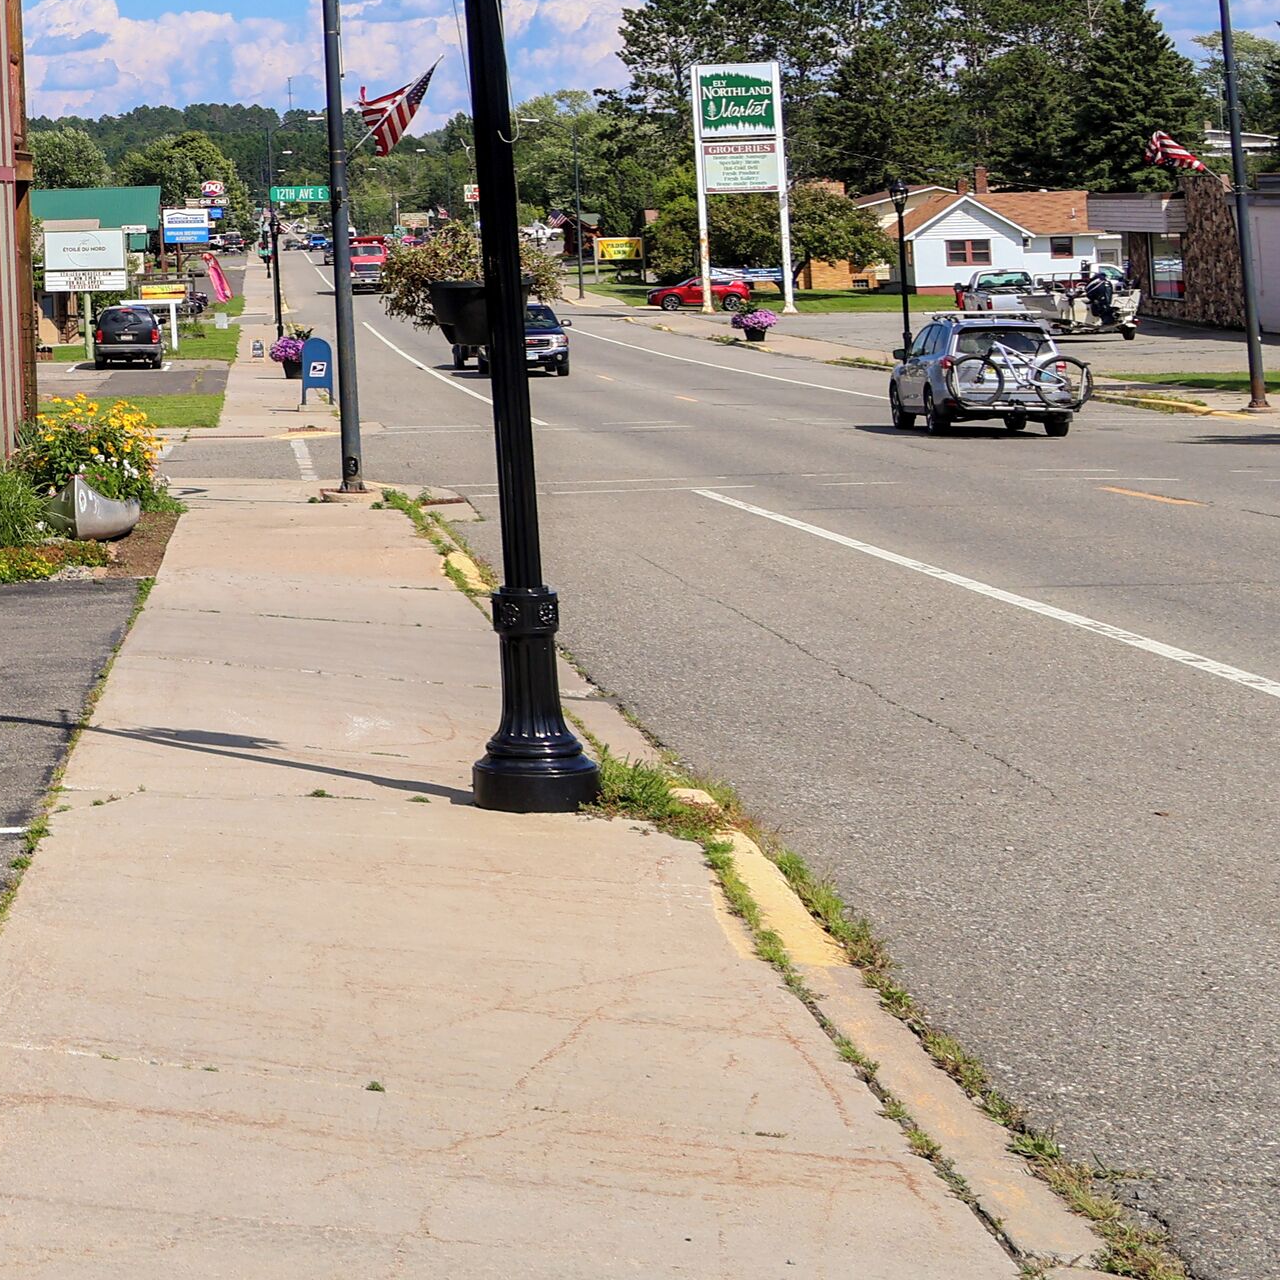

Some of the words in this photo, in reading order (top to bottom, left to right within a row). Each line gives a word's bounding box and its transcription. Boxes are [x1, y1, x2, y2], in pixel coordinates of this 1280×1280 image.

[704, 98, 771, 120] Market
[708, 144, 771, 154] GROCERIES
[205, 183, 221, 192] DQ
[276, 188, 295, 200] 12TH
[299, 188, 315, 199] AVE
[318, 188, 324, 199] E
